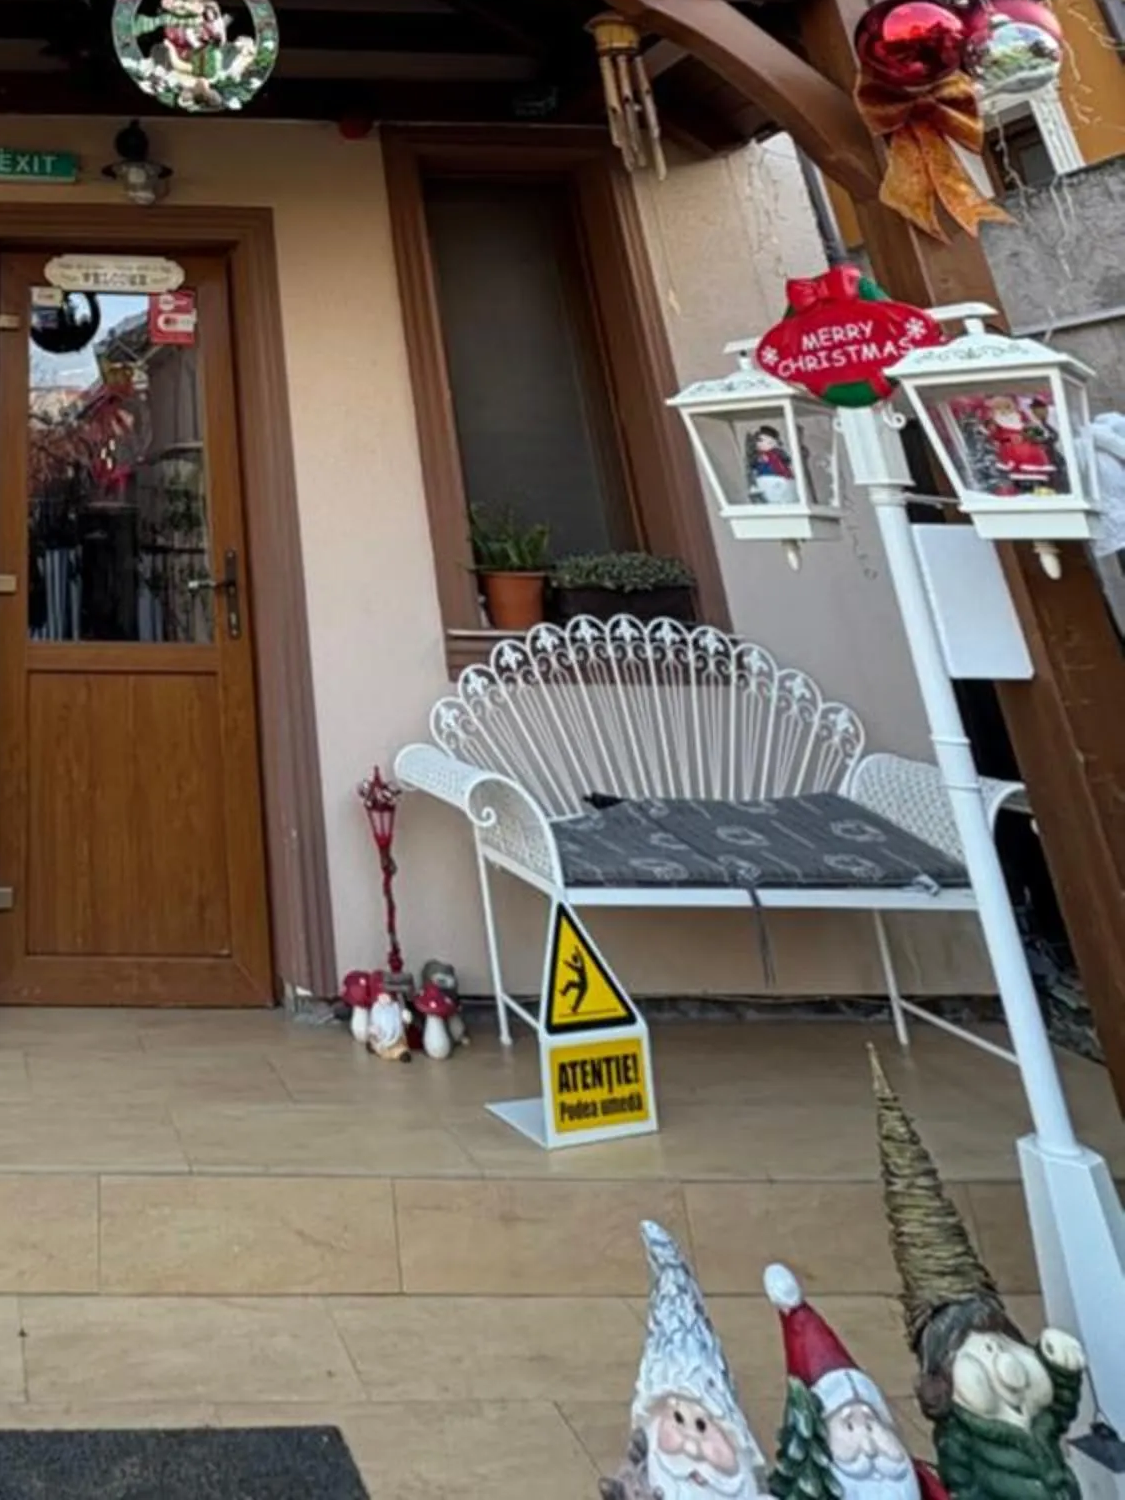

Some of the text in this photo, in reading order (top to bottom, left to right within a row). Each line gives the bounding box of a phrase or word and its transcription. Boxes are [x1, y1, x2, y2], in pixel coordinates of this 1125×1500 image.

[801, 319, 874, 351] MERRY
[777, 336, 914, 377] CHRISTMAS
[560, 1100, 598, 1123] Podea
